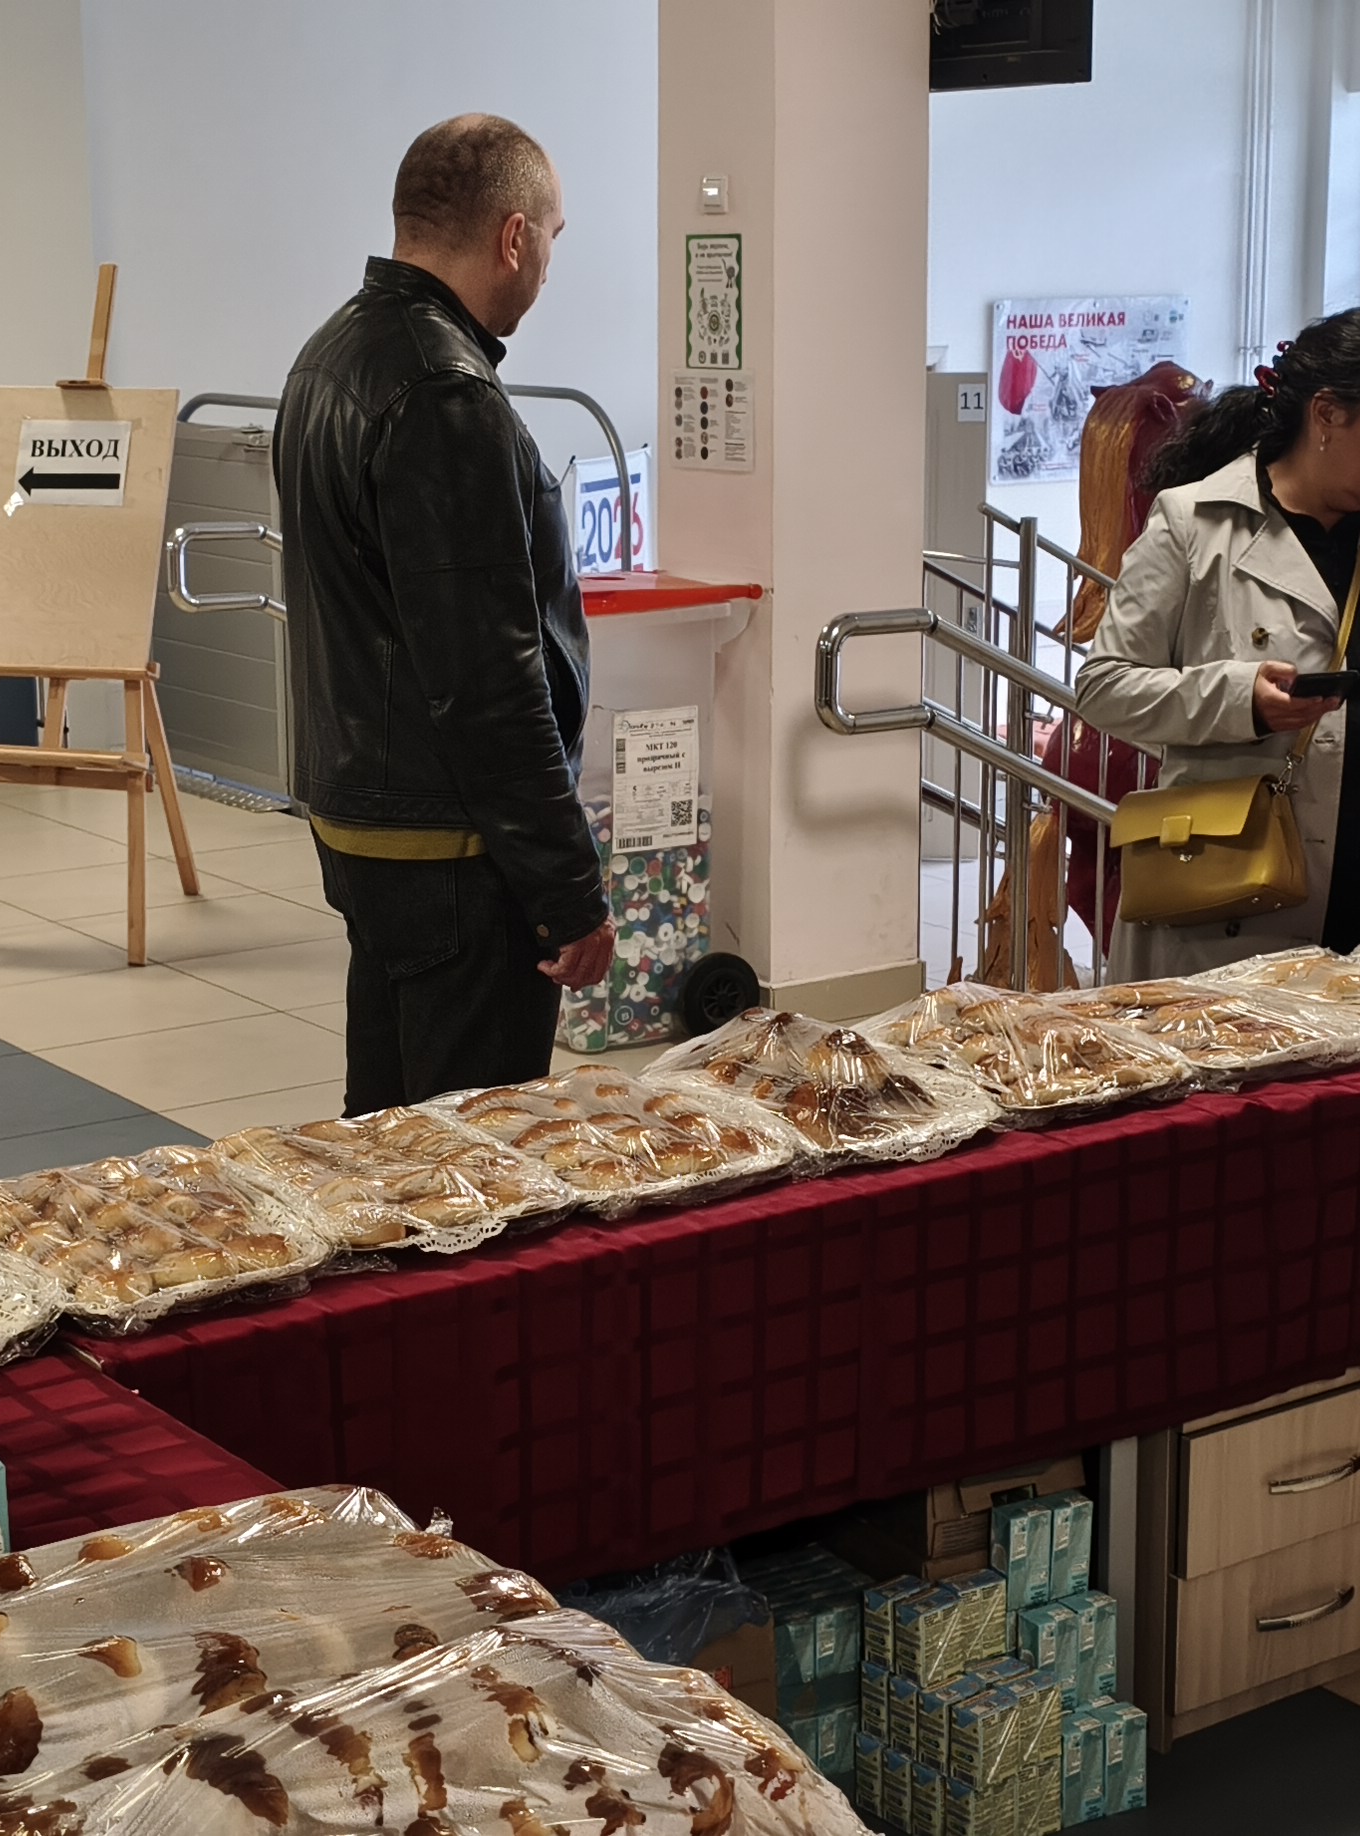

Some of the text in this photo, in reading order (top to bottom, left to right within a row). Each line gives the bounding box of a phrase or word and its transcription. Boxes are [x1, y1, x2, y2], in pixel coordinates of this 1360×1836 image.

[1006, 311, 1126, 330] НАША ВЕЛИКАЯ
[1006, 334, 1068, 350] ПОБЕДА
[960, 391, 984, 411] 11
[31, 439, 120, 461] ВЫХОД
